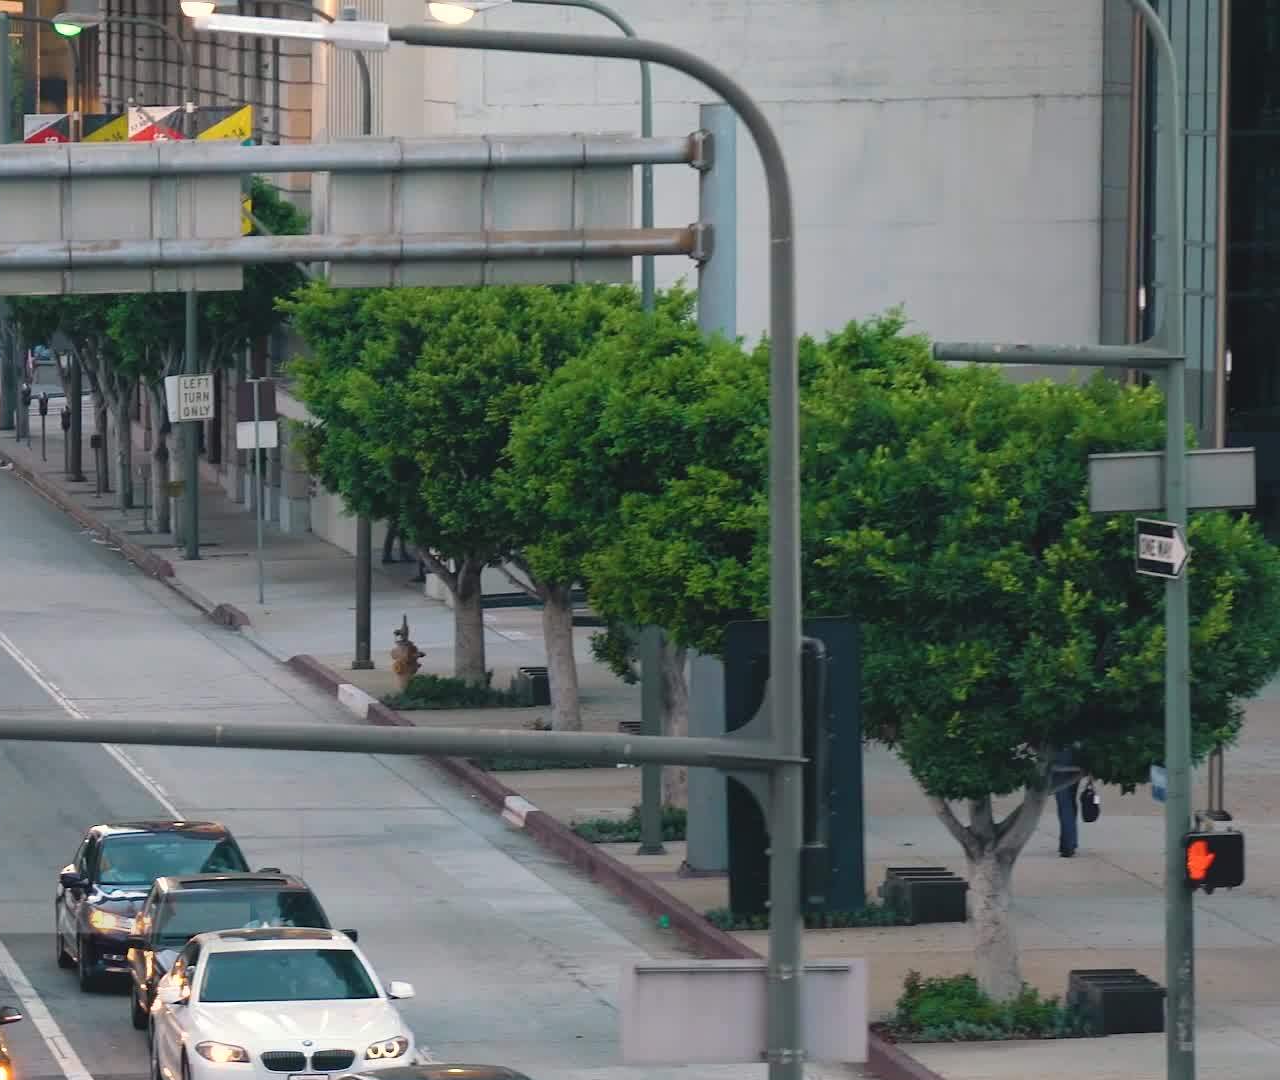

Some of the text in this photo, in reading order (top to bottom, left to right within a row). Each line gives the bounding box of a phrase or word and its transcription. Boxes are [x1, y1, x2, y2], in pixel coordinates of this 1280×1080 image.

[183, 378, 209, 389] LEFT
[183, 391, 209, 403] TURN
[183, 405, 210, 417] ONLY
